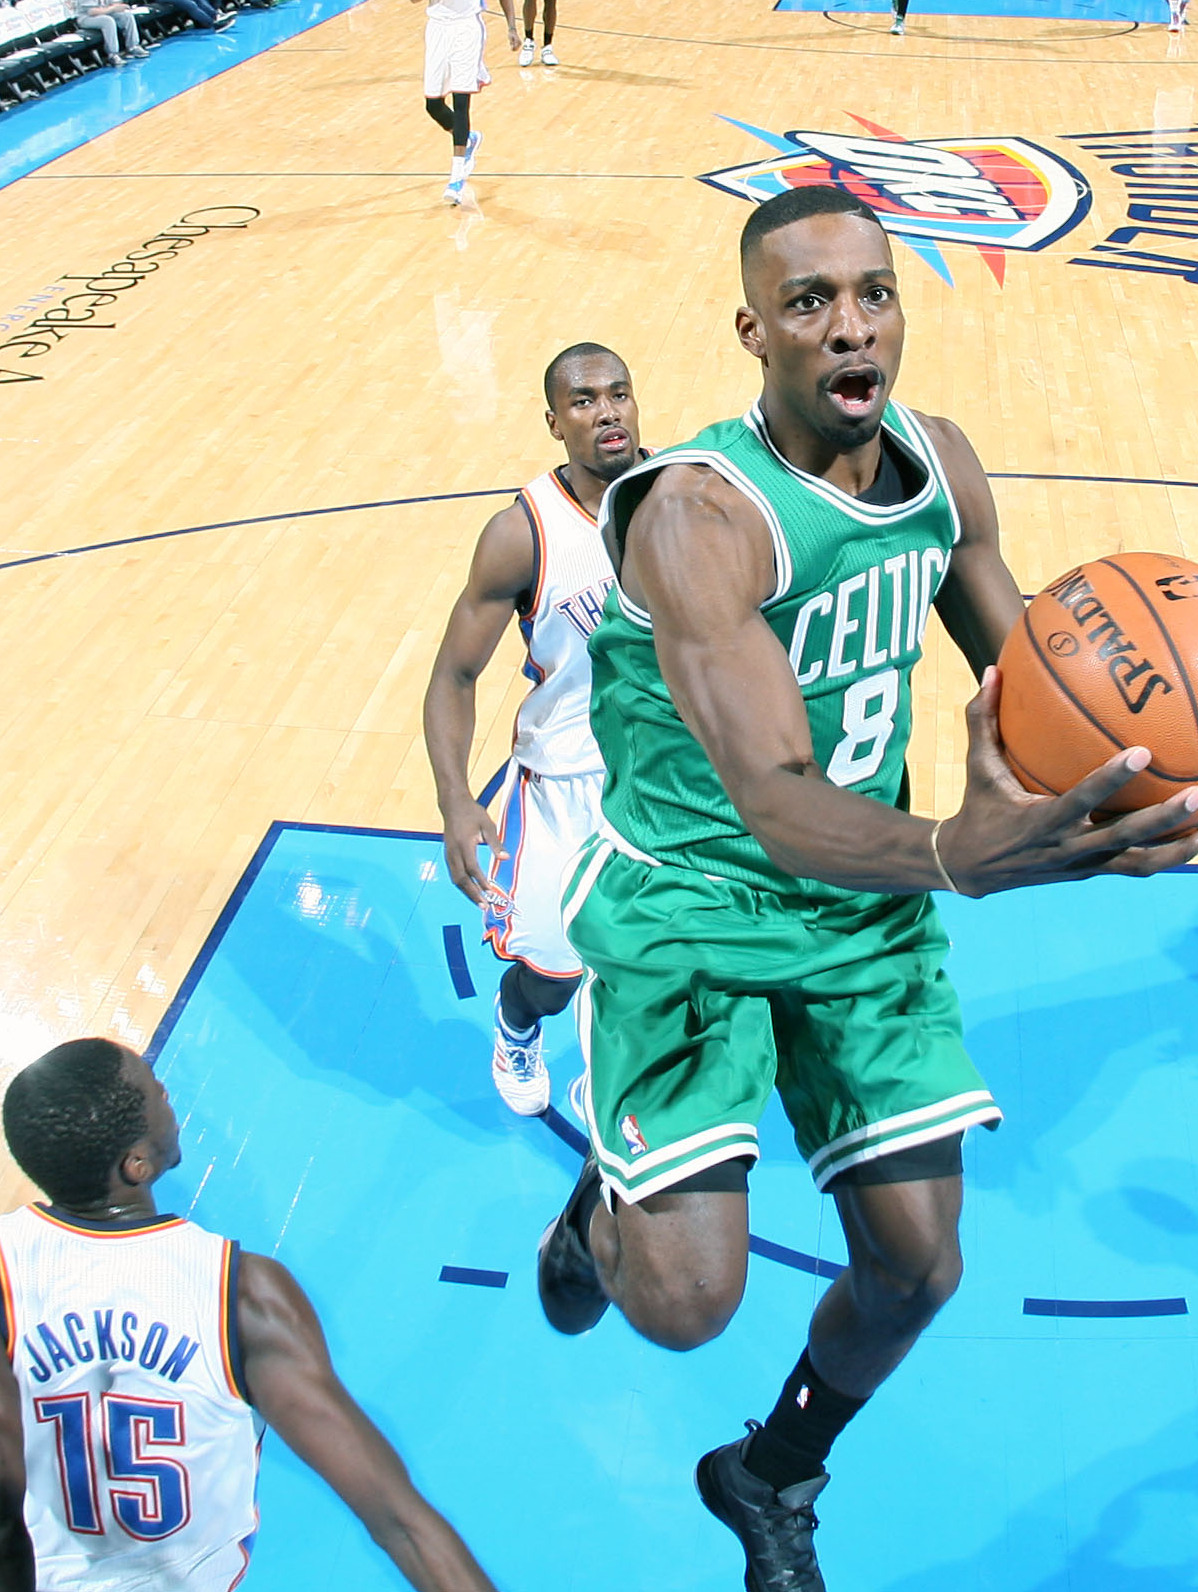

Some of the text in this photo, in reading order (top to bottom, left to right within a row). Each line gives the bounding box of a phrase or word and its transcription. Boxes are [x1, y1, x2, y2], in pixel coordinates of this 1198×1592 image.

[790, 131, 1028, 221] OKC
[0, 206, 261, 358] Chesapeake
[788, 547, 952, 687] CELTIC
[826, 667, 899, 787] 8
[23, 1309, 200, 1383] JACKSON
[33, 1391, 192, 1542] 15
